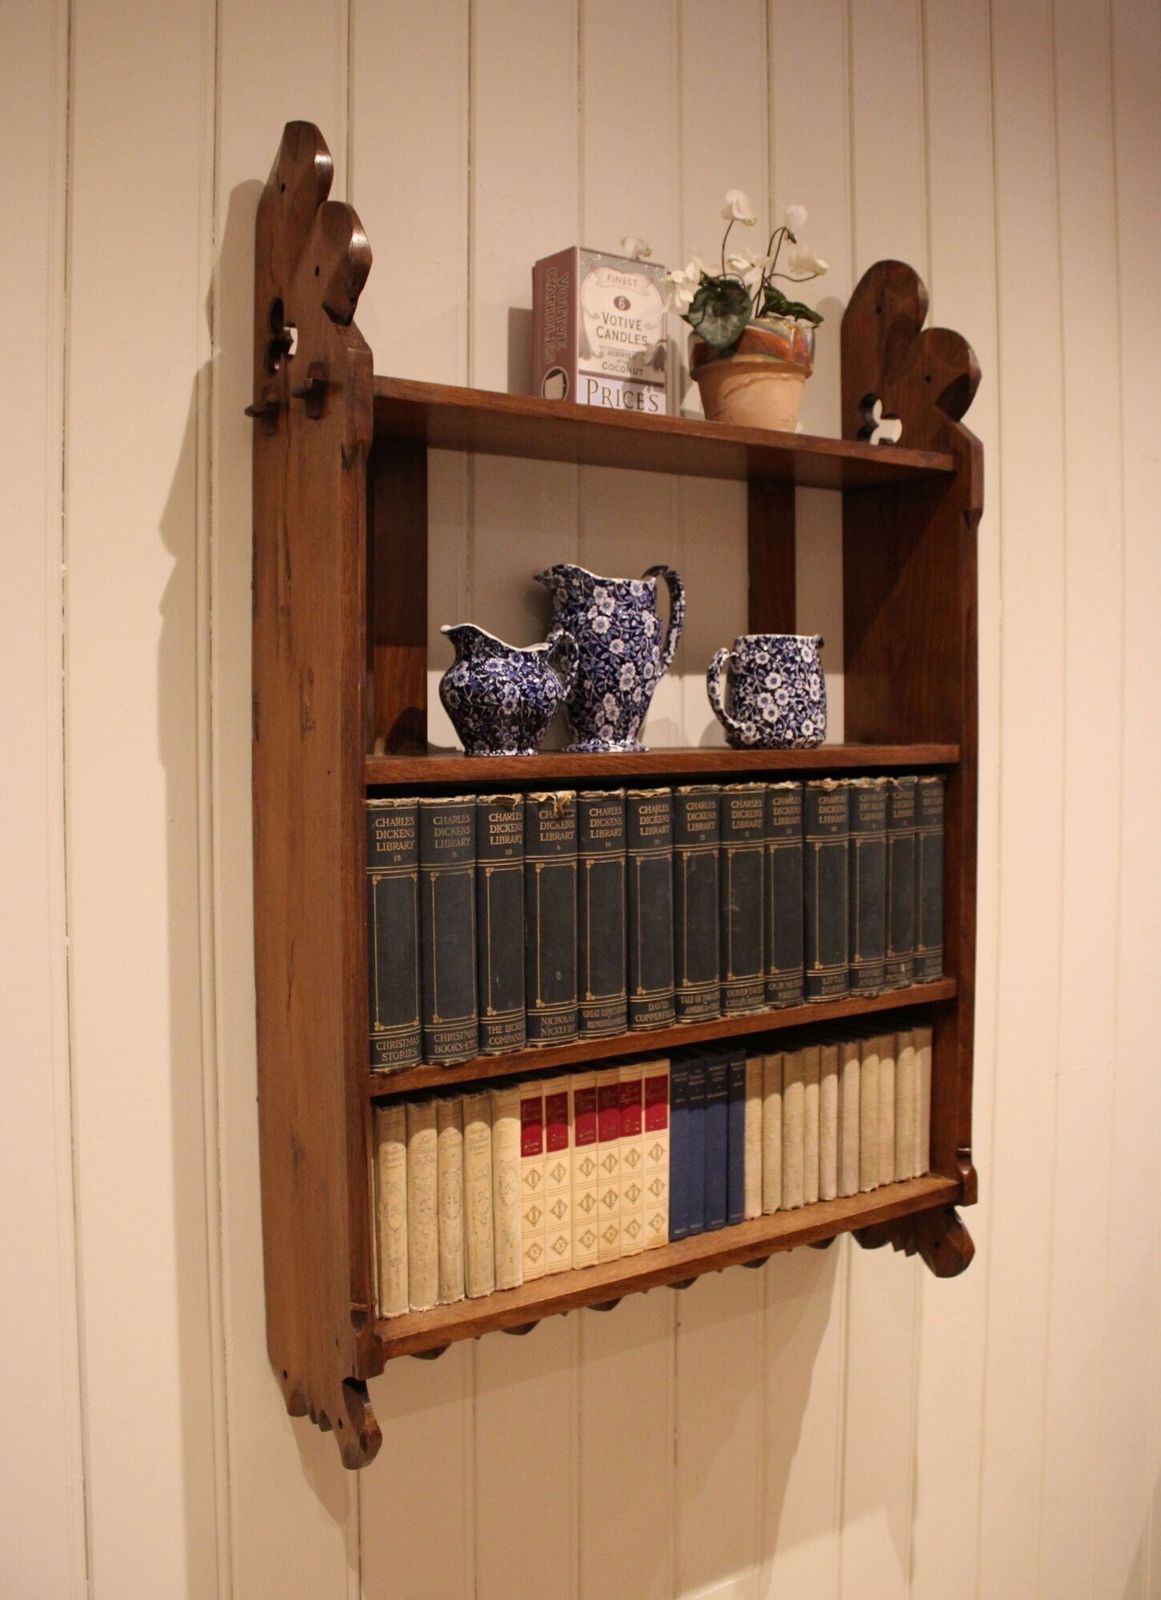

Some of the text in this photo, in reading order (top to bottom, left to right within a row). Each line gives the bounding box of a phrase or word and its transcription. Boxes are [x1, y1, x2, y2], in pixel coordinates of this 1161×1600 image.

[606, 272, 639, 288] FINEST
[601, 311, 643, 332] VOTIVE
[596, 325, 649, 346] CANDLES
[601, 361, 645, 377] COCONUT
[638, 804, 669, 815] CHARLES
[686, 801, 716, 811] CHARLES
[731, 799, 762, 809] CHARLES
[589, 806, 622, 817] CHARLES
[687, 811, 716, 821] DICKENS
[731, 809, 763, 819] DICKENS
[375, 816, 415, 828] CHARLES
[433, 814, 471, 825] CHARLES
[539, 820, 575, 830] DICKENS
[589, 817, 623, 828] DICKENS
[639, 815, 670, 825] DICKENS
[732, 819, 763, 829] LIBRARY
[434, 826, 471, 837] DICKENS
[640, 825, 670, 836] LIBRARY
[687, 821, 716, 832] LIBRARY
[375, 828, 415, 840] DICKENS
[540, 831, 575, 842] LIBRARY
[590, 828, 623, 839] LIBRARY
[376, 840, 415, 852] LIBRARY
[435, 838, 471, 849] LIBRARY
[487, 1025, 503, 1035] THE
[376, 1037, 419, 1051] CHRISTMAS
[381, 1048, 417, 1062] STORIES
